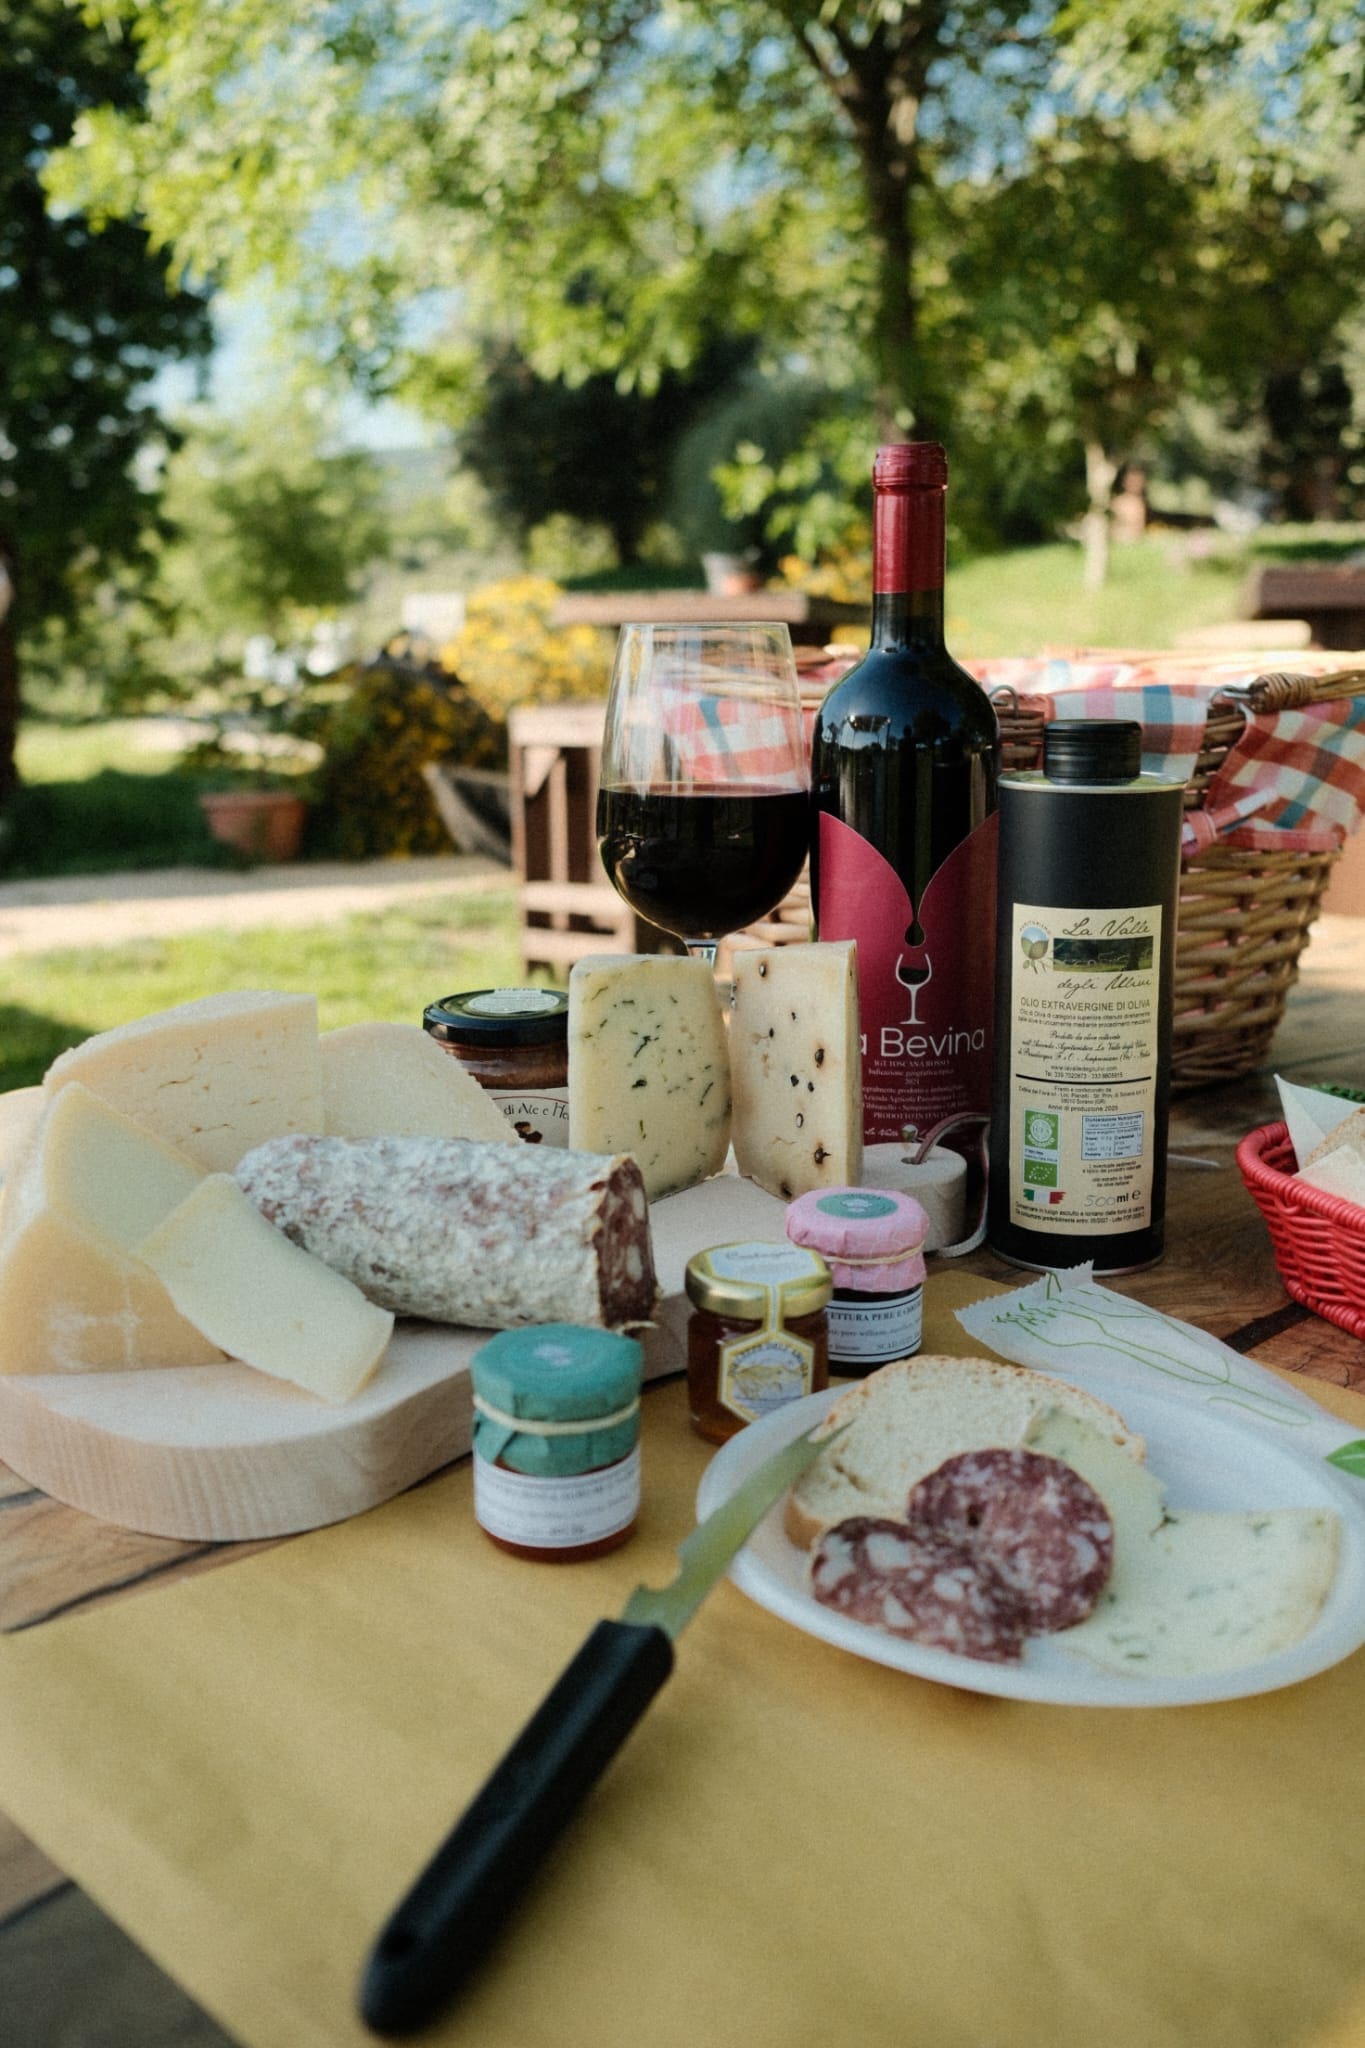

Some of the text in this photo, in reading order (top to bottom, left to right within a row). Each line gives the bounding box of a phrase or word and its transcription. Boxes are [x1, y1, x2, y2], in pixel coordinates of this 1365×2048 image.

[1062, 915, 1151, 937] La Valle
[1057, 977, 1097, 999] degli
[1020, 997, 1151, 1012] OLIO EXTRAVERGINE DI OLIVA
[880, 1026, 985, 1057] Bevina
[503, 1104, 514, 1116] di
